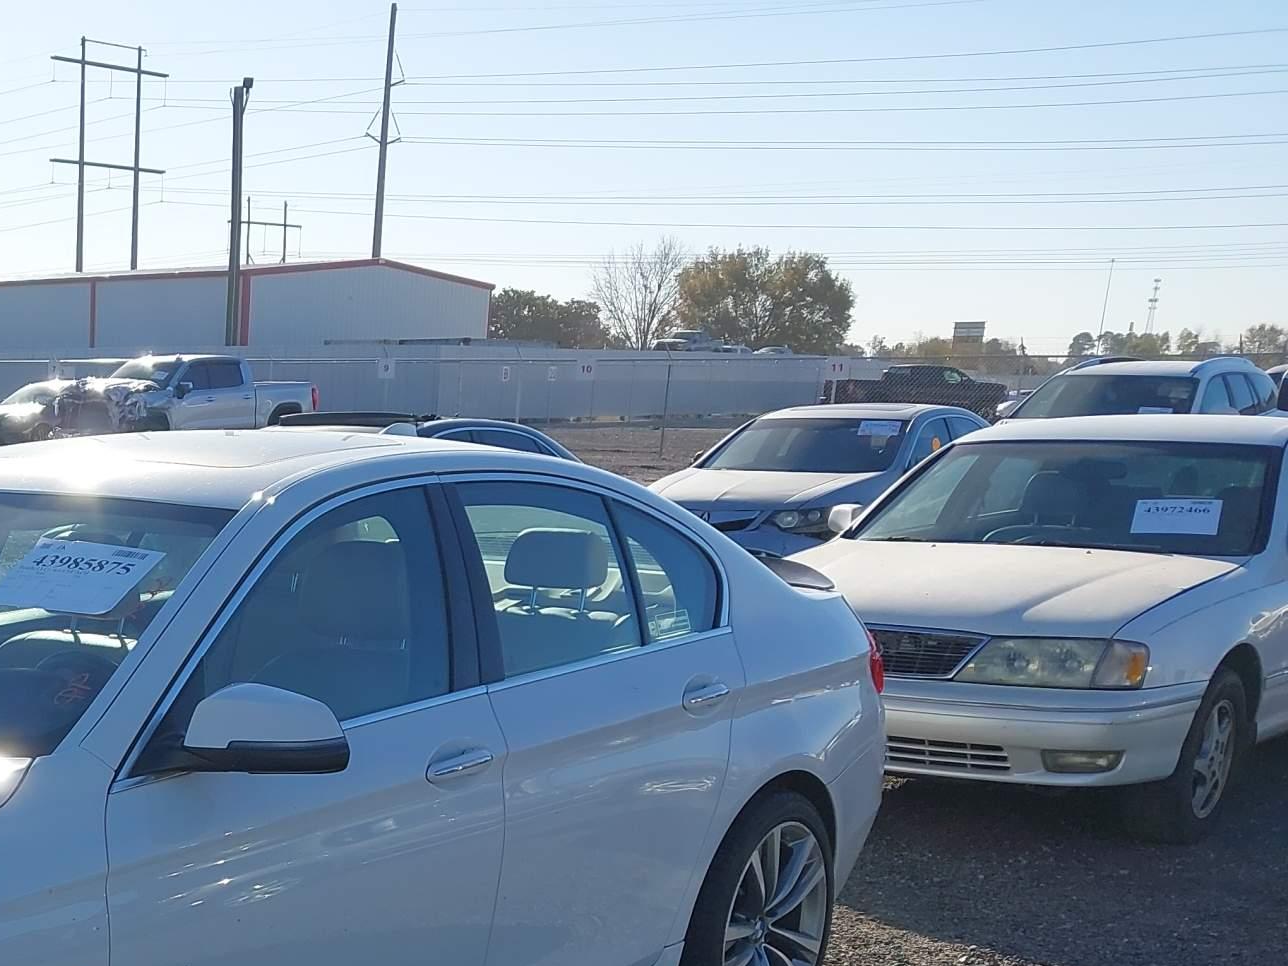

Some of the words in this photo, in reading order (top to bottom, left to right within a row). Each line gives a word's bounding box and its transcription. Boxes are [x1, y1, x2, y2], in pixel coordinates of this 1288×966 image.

[581, 364, 593, 374] 10
[831, 362, 844, 373] 11
[1143, 505, 1212, 514] 43972466
[32, 553, 137, 577] 43985875
